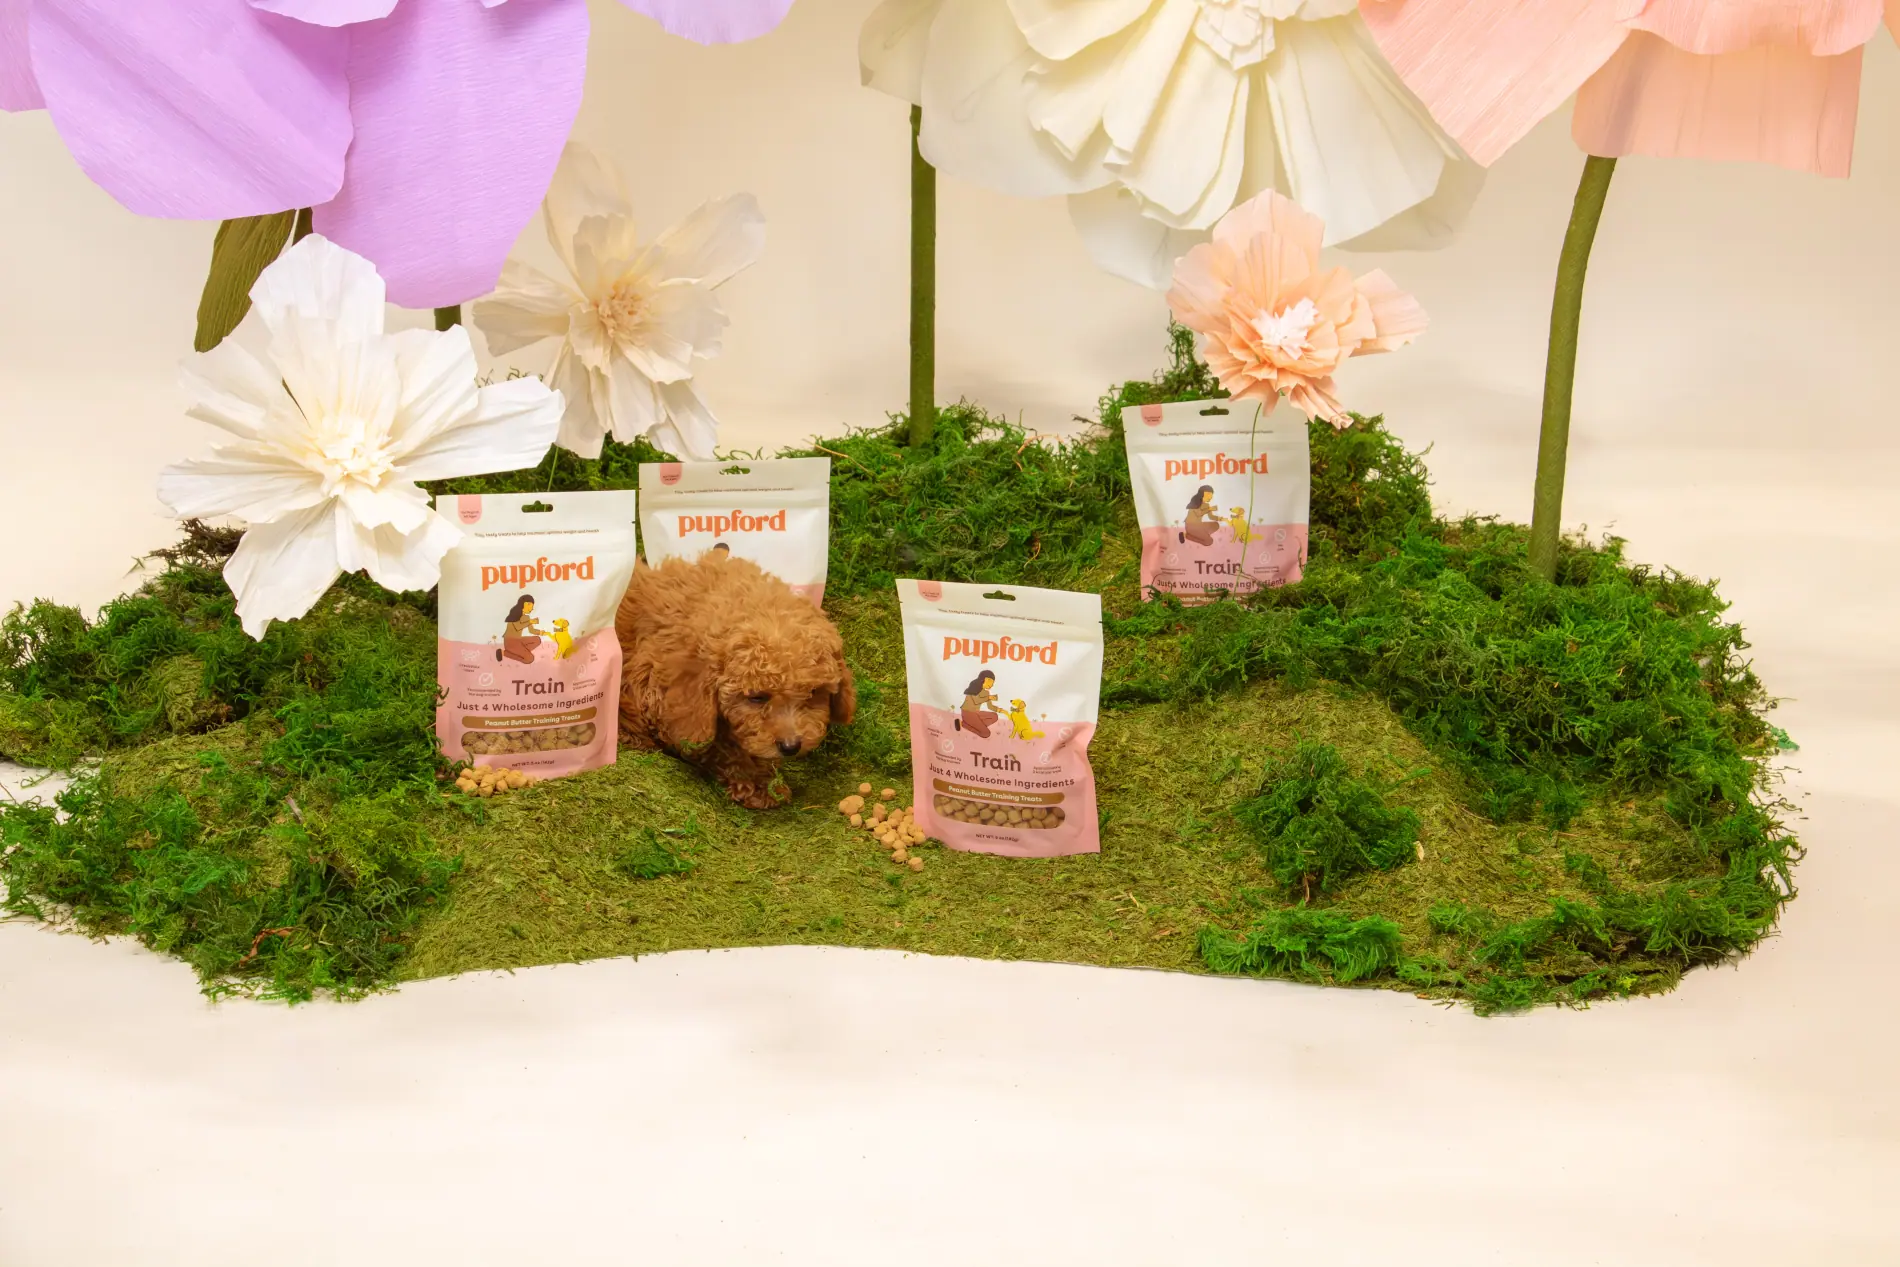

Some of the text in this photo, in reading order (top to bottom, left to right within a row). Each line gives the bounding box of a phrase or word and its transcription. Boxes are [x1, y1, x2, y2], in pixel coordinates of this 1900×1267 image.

[1165, 452, 1269, 481] pupford
[678, 509, 787, 538] pupford
[481, 556, 595, 591] pupford
[1171, 581, 1177, 589] 4
[1179, 580, 1234, 589] Wholesome
[943, 636, 1058, 665] pupford
[511, 677, 565, 696] Train
[457, 691, 604, 712] Just 4 Wholesome Ingredients
[484, 719, 509, 727] Peanut
[510, 718, 532, 726] Butter
[532, 717, 560, 725] Training
[969, 751, 1021, 772] Train
[929, 763, 944, 775] Just
[954, 770, 1012, 786] Wholesome
[1014, 778, 1075, 789] Ingredients
[948, 785, 971, 795] Peanut
[971, 789, 992, 798] Butter
[992, 792, 1020, 802] Training
